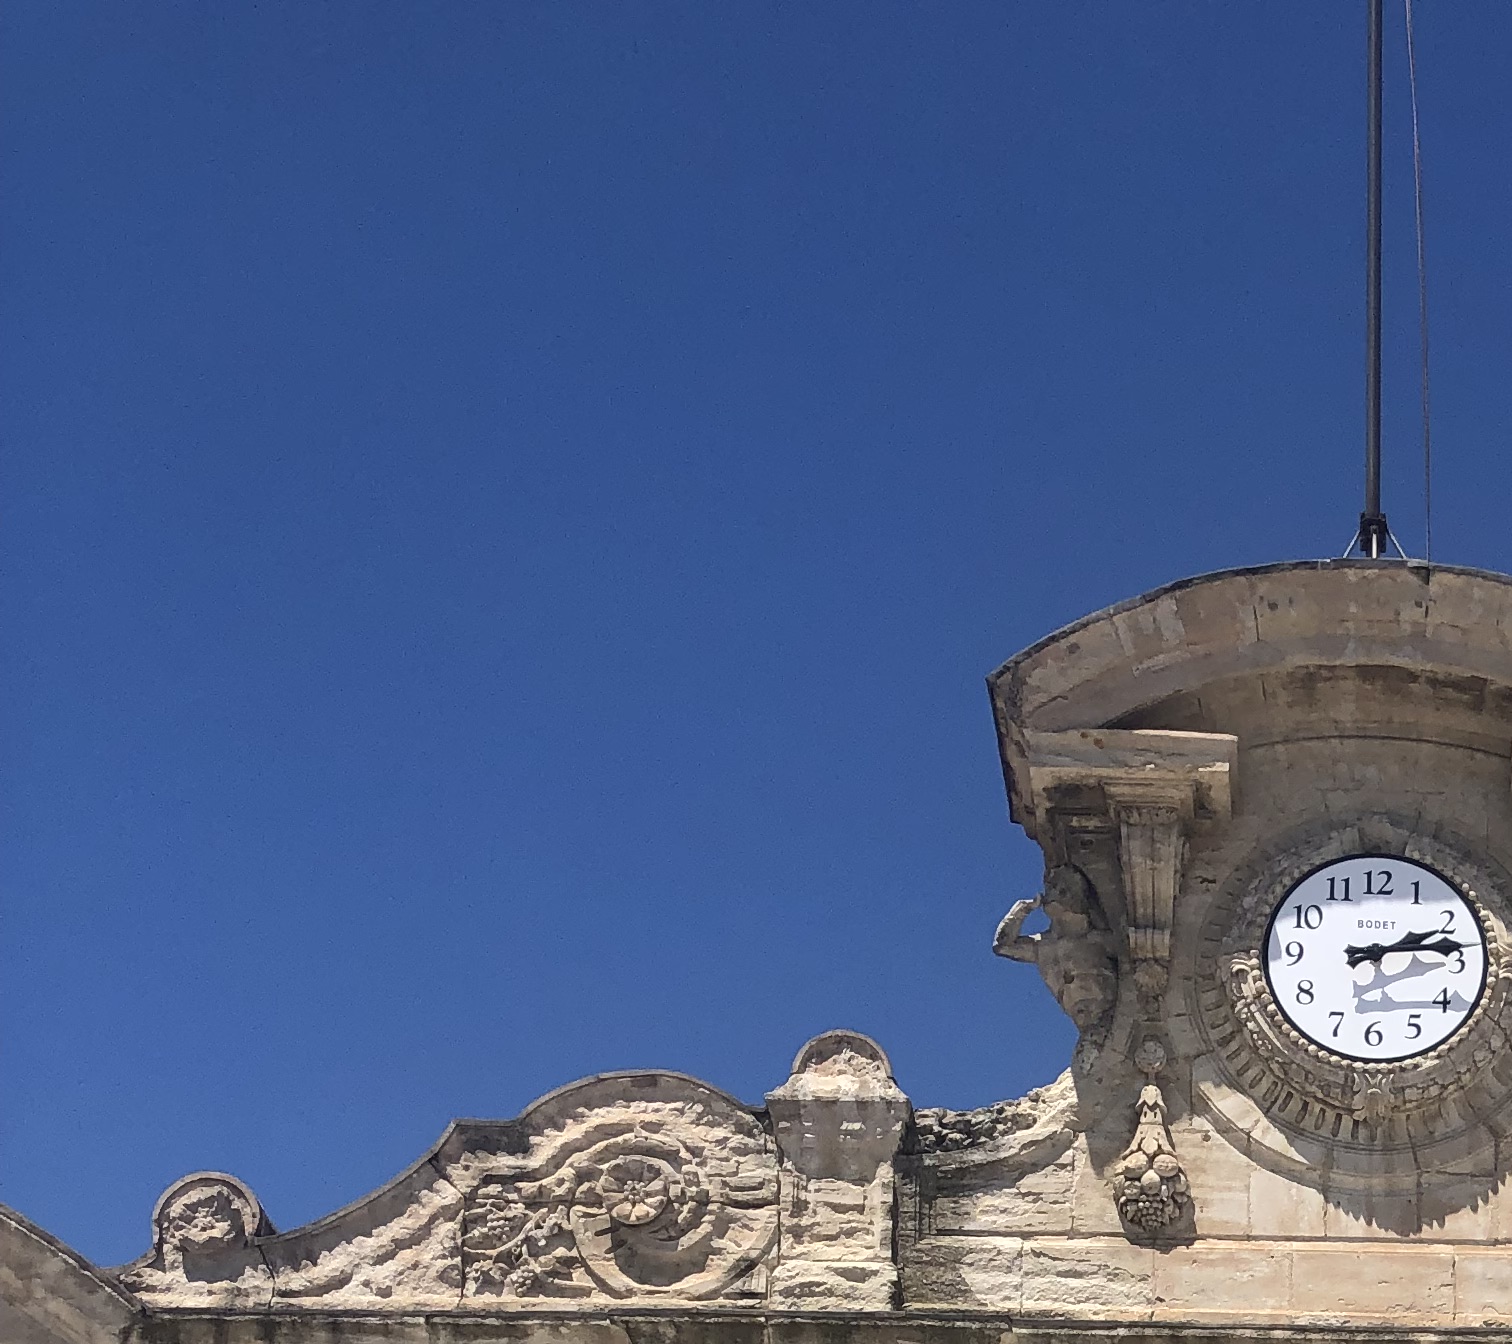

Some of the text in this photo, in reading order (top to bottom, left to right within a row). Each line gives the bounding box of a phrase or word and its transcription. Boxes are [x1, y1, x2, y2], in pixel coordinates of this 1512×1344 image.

[1325, 876, 1353, 902] 11
[1362, 869, 1394, 896] 12
[1410, 880, 1423, 906] 1
[1292, 904, 1323, 930] 10
[1357, 919, 1397, 930] BODET
[1438, 910, 1457, 935] 2
[1285, 941, 1304, 967] 9
[1447, 949, 1466, 974] 3
[1295, 979, 1315, 1005] 8
[1432, 987, 1452, 1014] 4
[1327, 1011, 1345, 1038] 7
[1364, 1020, 1383, 1047] 6
[1404, 1013, 1422, 1040] 5
